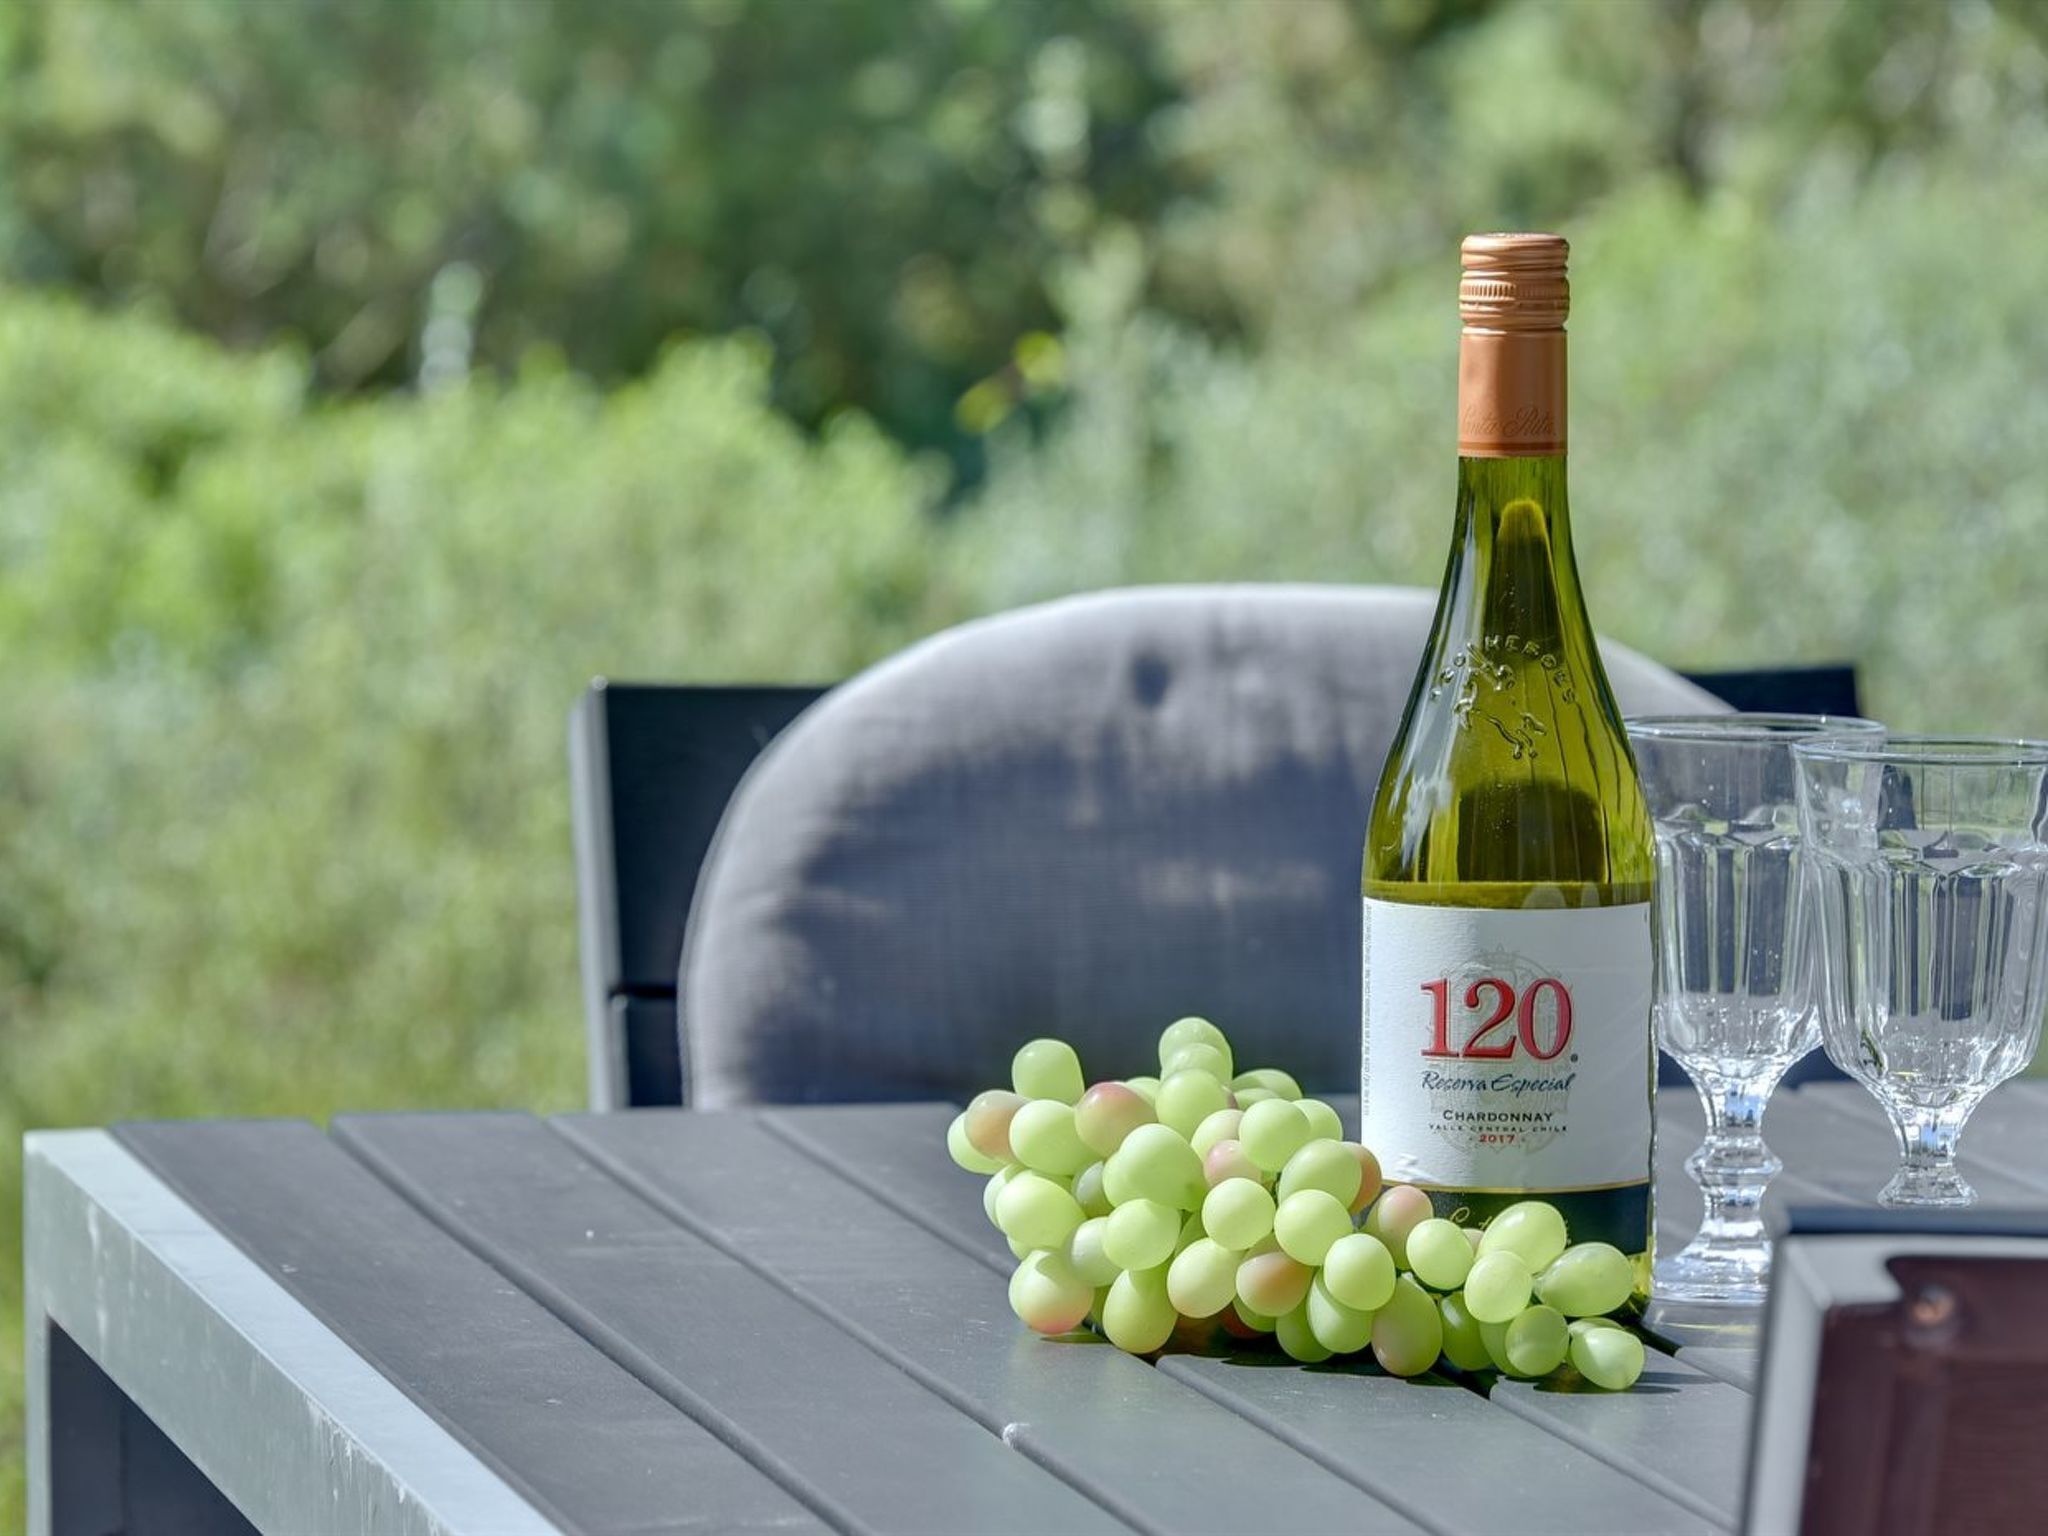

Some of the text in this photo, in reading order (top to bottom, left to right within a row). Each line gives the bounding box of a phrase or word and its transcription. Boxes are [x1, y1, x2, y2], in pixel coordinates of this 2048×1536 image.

[1420, 978, 1572, 1060] 120
[1421, 1070, 1576, 1098] Reserva Especial
[1442, 1109, 1552, 1123] CHARDONNAY
[1429, 1123, 1568, 1133] VALLE CENTRAL CHILE
[1478, 1134, 1516, 1144] 2017
